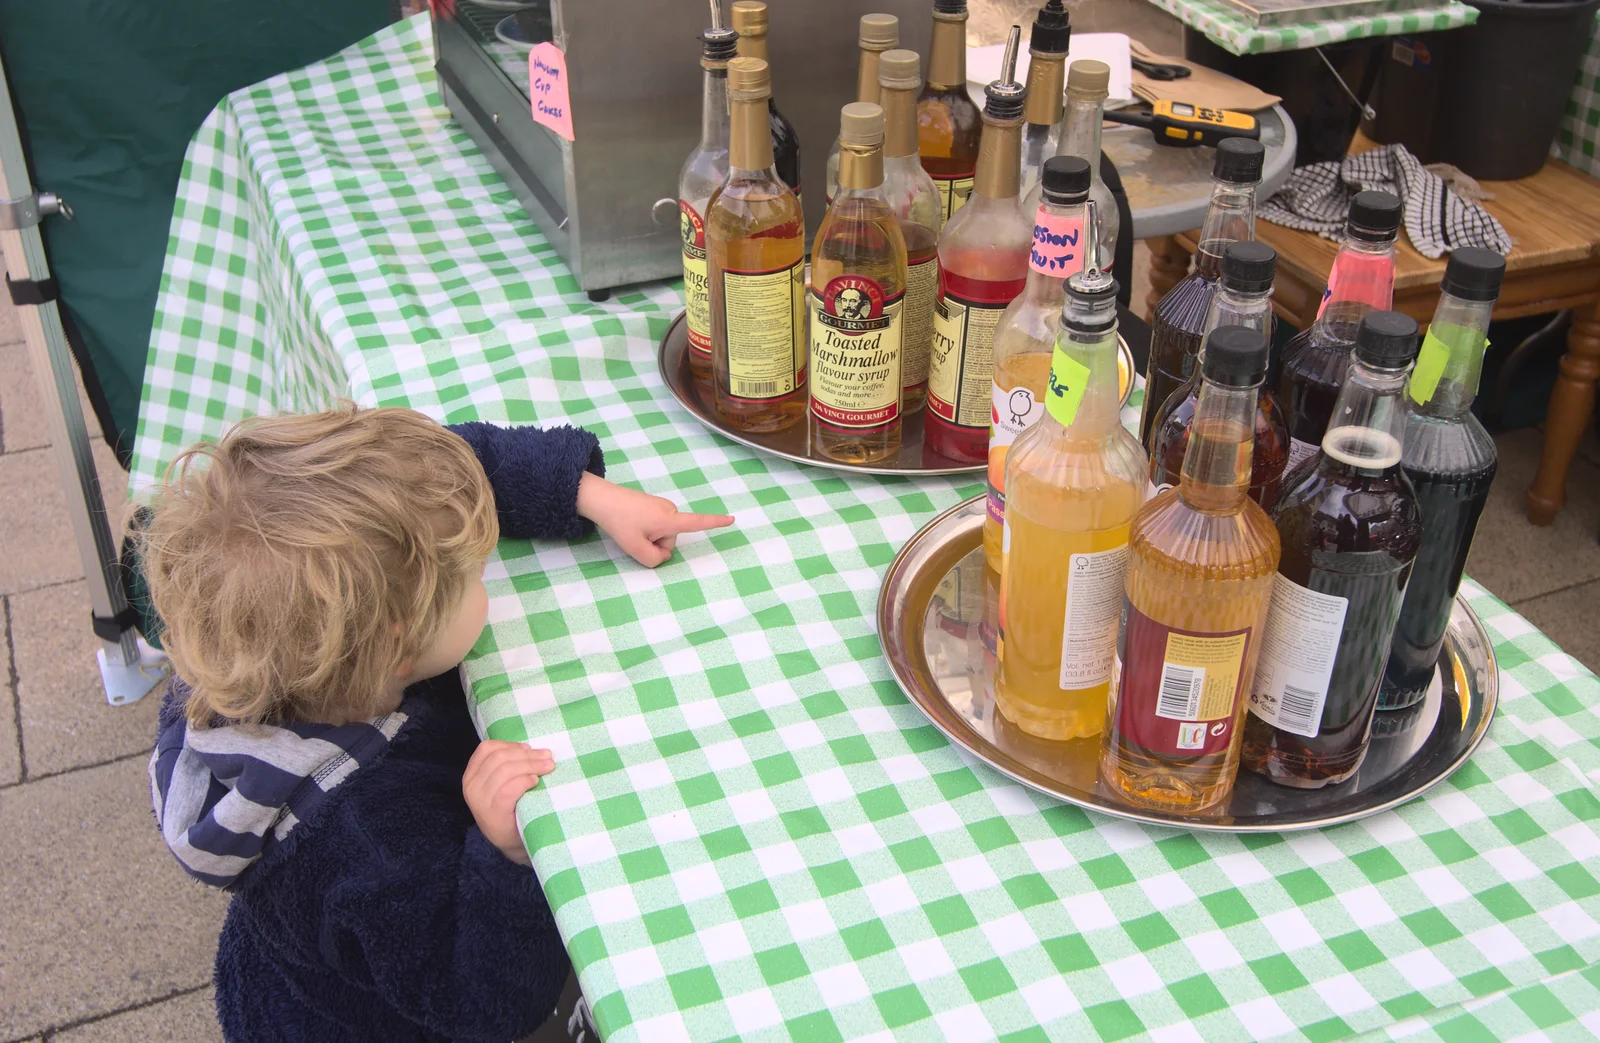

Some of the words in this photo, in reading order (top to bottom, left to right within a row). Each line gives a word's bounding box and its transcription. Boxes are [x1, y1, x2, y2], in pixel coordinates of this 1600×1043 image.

[684, 266, 708, 292] ange
[820, 314, 887, 329] GOURMET
[826, 330, 882, 350] Toasted
[812, 338, 898, 368] Marshmallow
[816, 360, 855, 381] flavour
[858, 368, 890, 384] syrup
[820, 376, 842, 388] Flavour
[844, 384, 860, 392] your
[862, 382, 884, 392] coffee,
[820, 384, 836, 395] sodas
[815, 402, 822, 412] DA
[823, 408, 845, 419] VINCI
[846, 409, 890, 420] GOURMET
[834, 398, 856, 408] 750ml
[988, 498, 1004, 519] Pass
